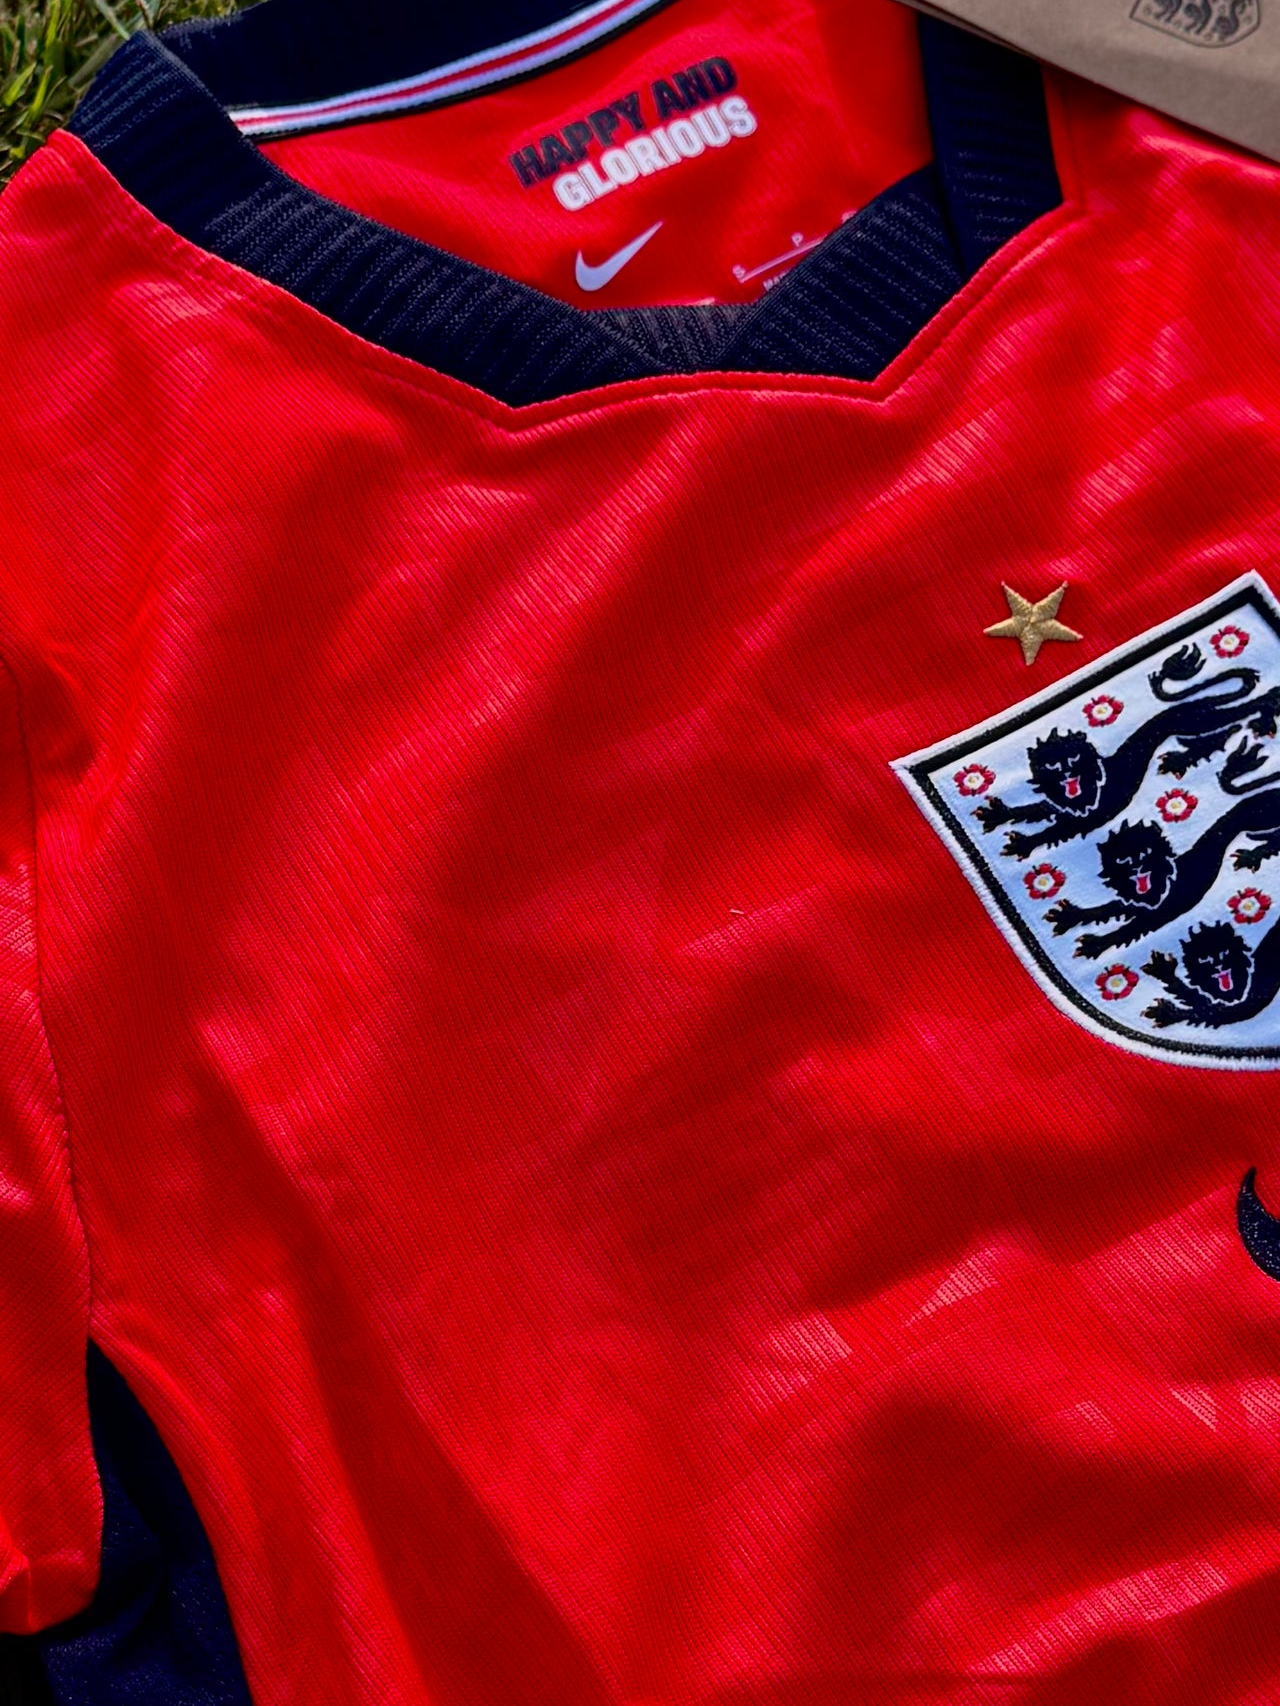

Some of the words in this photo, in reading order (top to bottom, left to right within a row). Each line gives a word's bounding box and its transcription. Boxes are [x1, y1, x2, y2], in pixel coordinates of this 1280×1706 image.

[509, 91, 645, 189] HAPPY
[651, 56, 737, 120] AND
[552, 95, 757, 211] GLORIOUS
